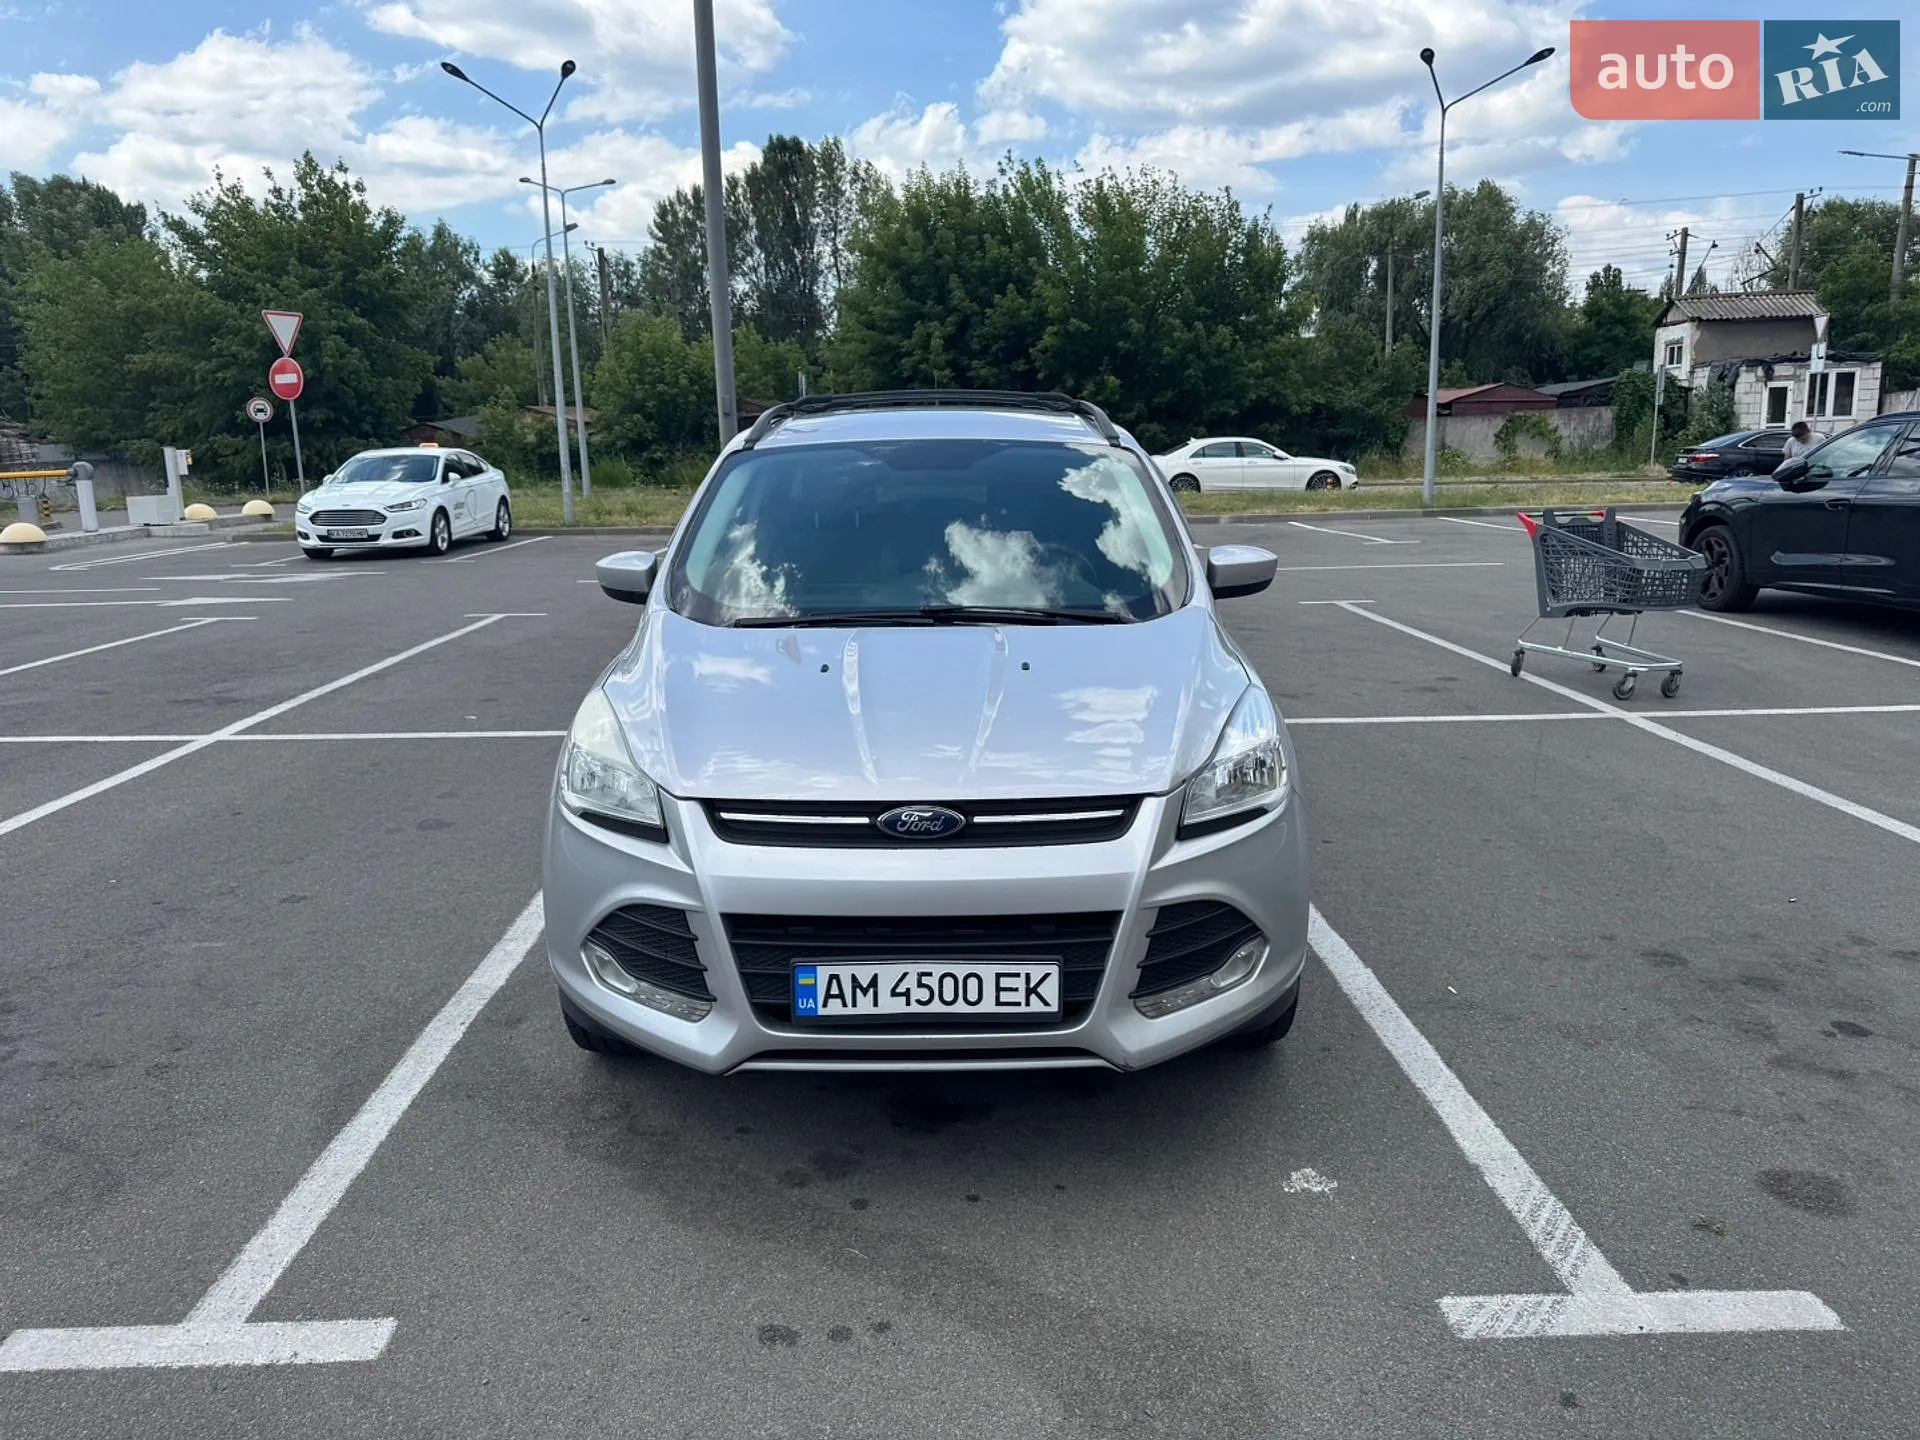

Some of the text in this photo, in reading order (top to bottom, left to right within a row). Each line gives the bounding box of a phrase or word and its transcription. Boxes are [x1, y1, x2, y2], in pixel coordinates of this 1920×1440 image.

[896, 811, 945, 832] Ford
[821, 971, 1053, 1009] AM 4500 EK
[798, 998, 816, 1010] UA
